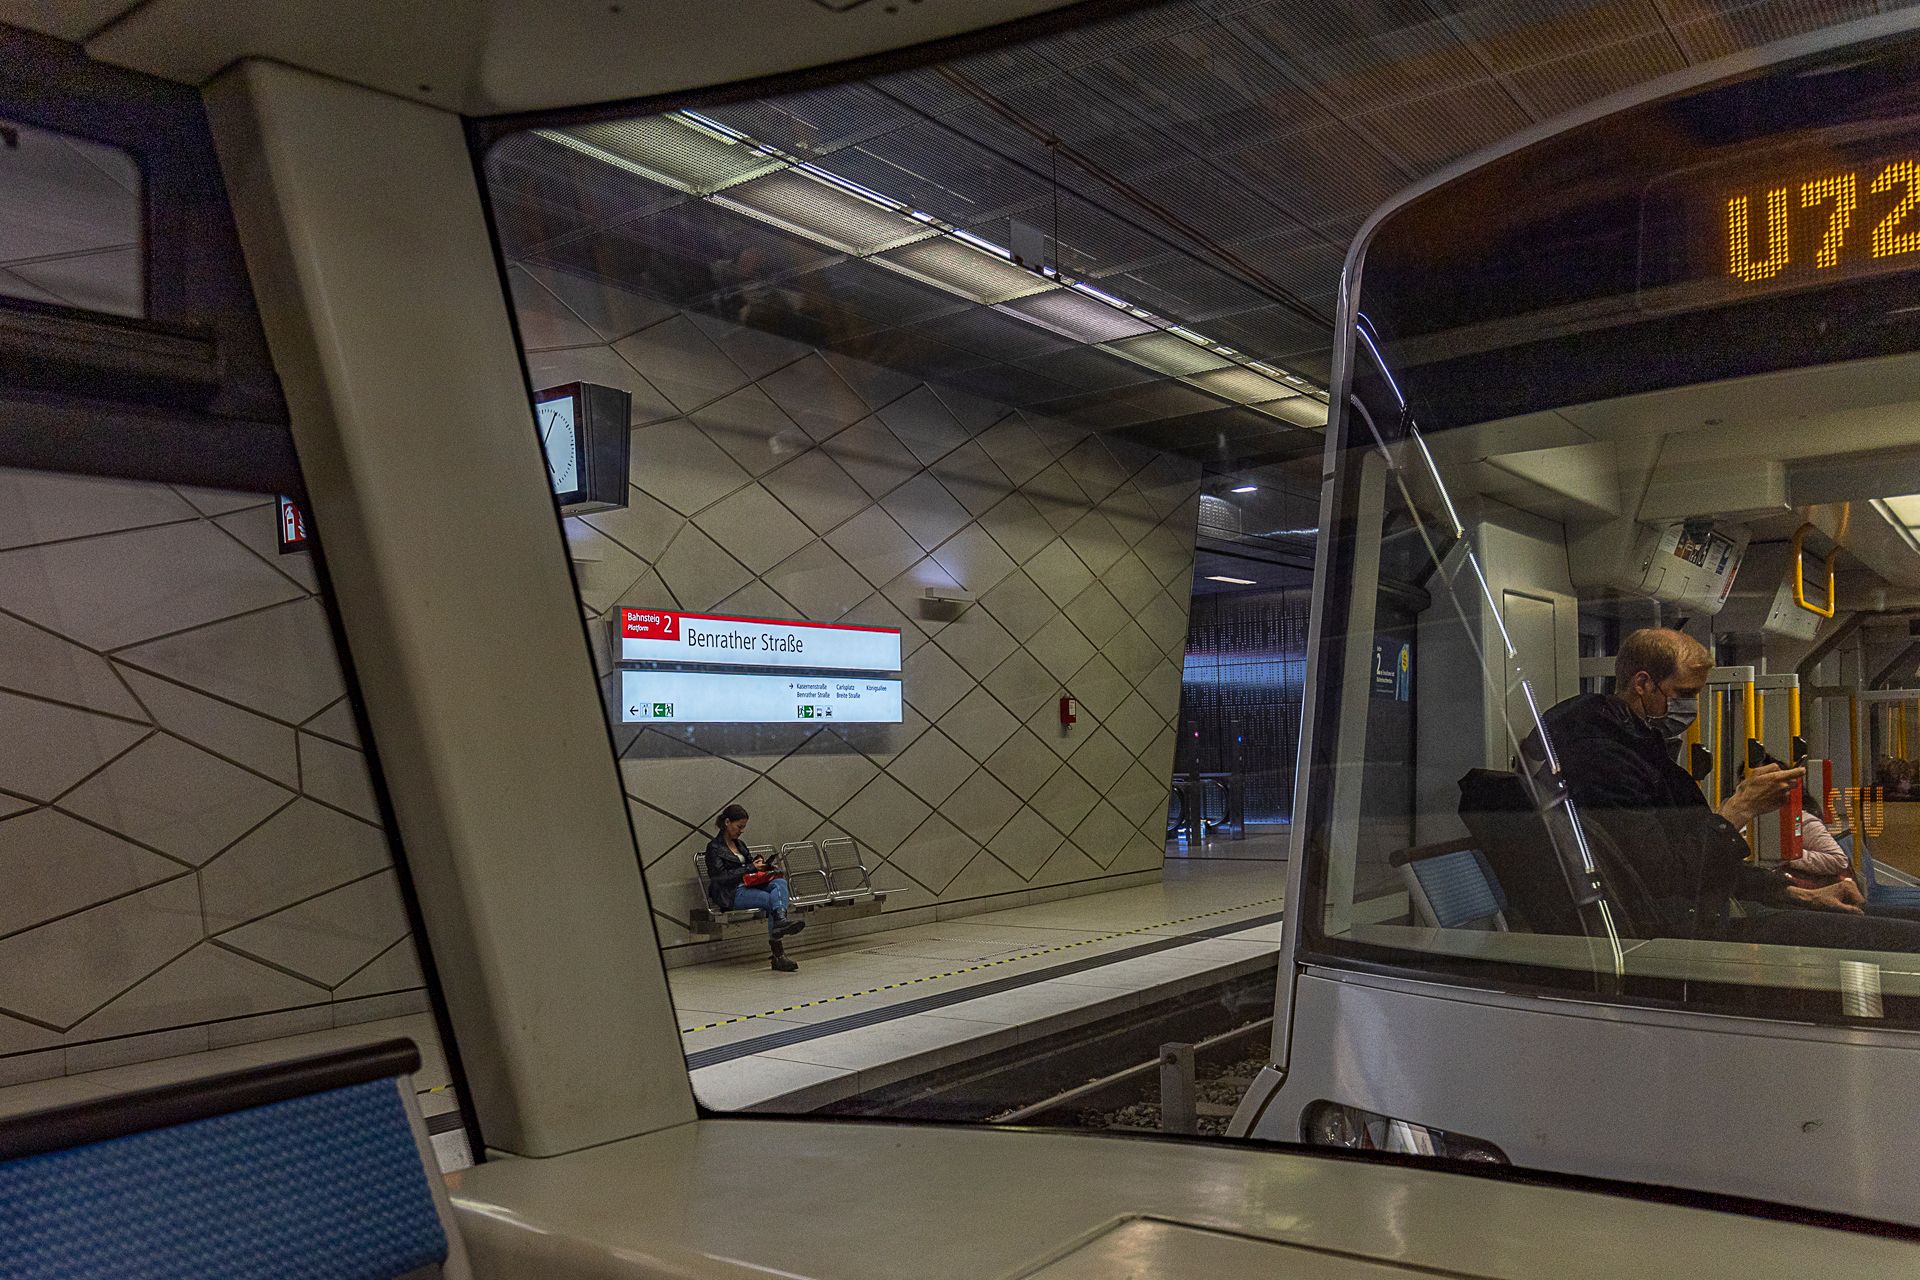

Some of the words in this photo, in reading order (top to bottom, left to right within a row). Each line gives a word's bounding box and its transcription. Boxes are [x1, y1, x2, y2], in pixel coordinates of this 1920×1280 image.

[1728, 160, 1920, 282] U72
[627, 612, 660, 625] Bahnsteig
[663, 615, 673, 633] 2
[627, 624, 649, 632] Platform
[688, 628, 756, 650] Benrather
[761, 633, 804, 653] Straße
